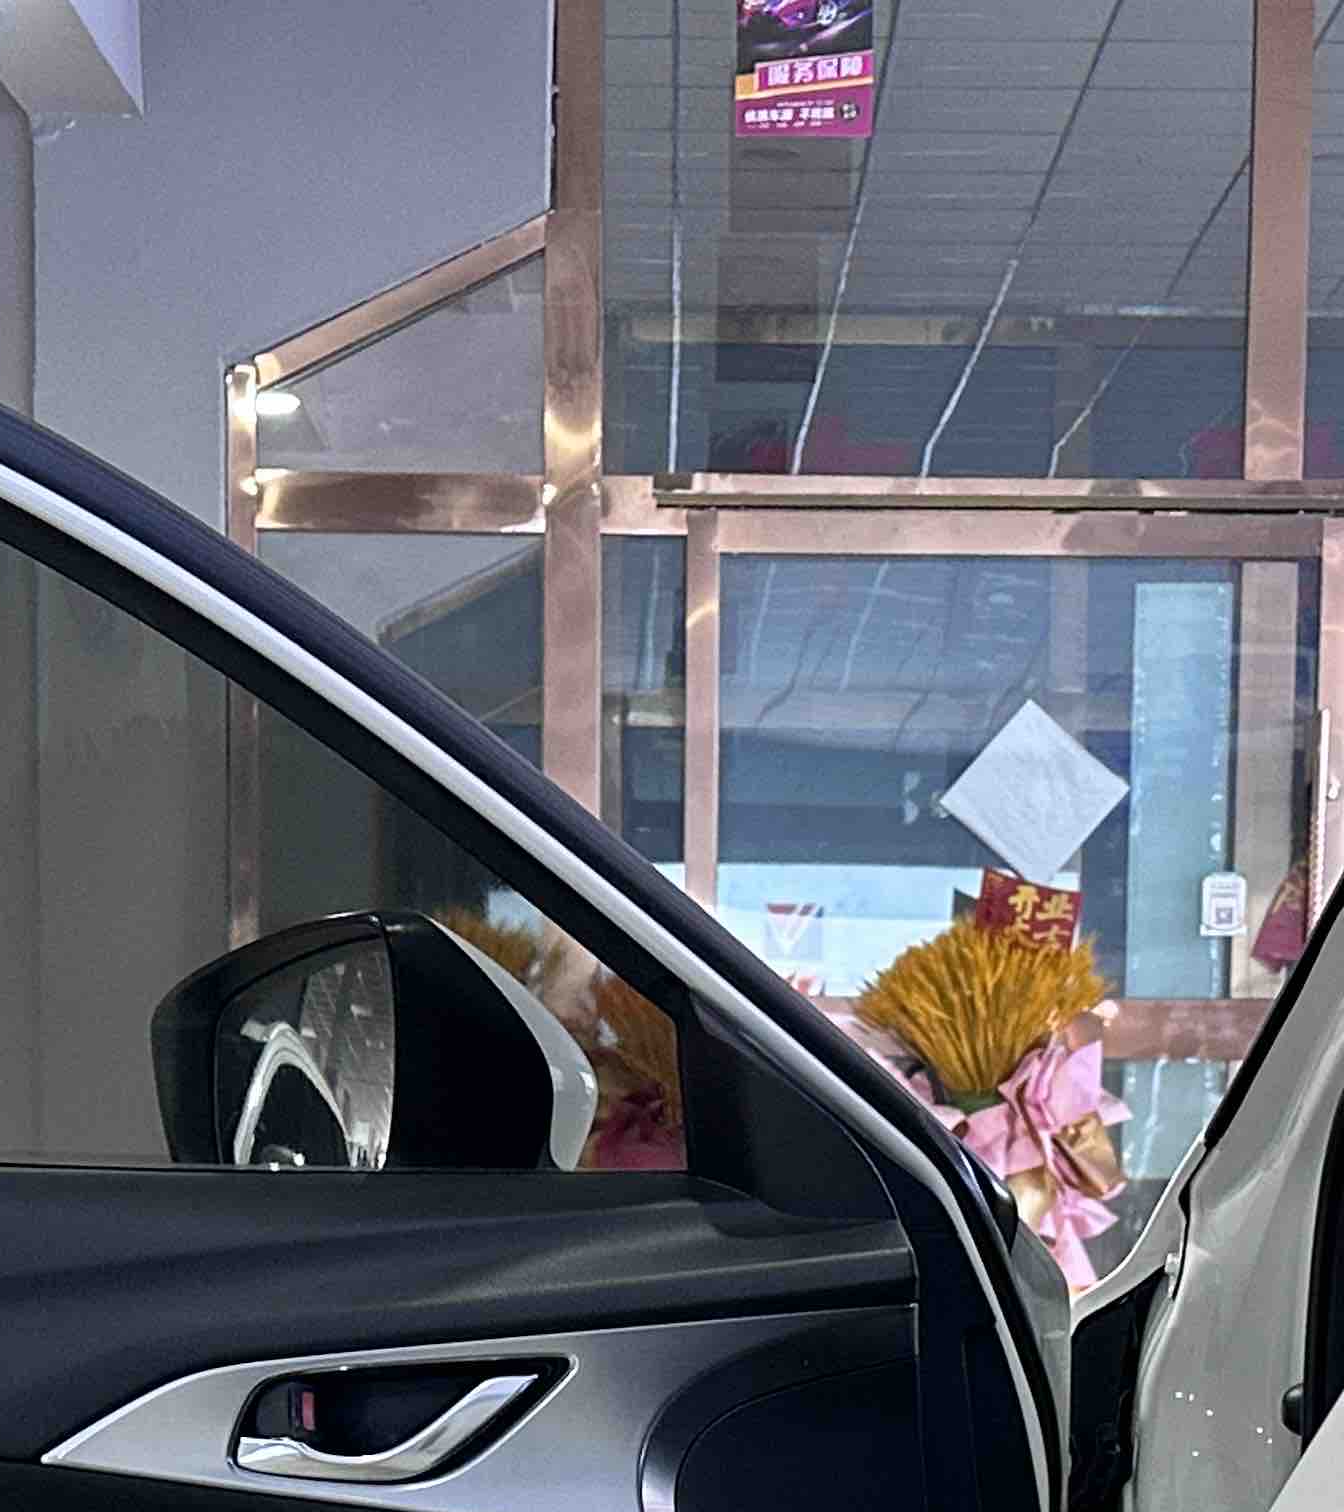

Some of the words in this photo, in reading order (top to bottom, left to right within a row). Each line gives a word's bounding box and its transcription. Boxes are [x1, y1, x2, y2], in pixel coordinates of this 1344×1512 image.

[767, 55, 864, 86] 服务保障
[1008, 884, 1073, 921] 开业
